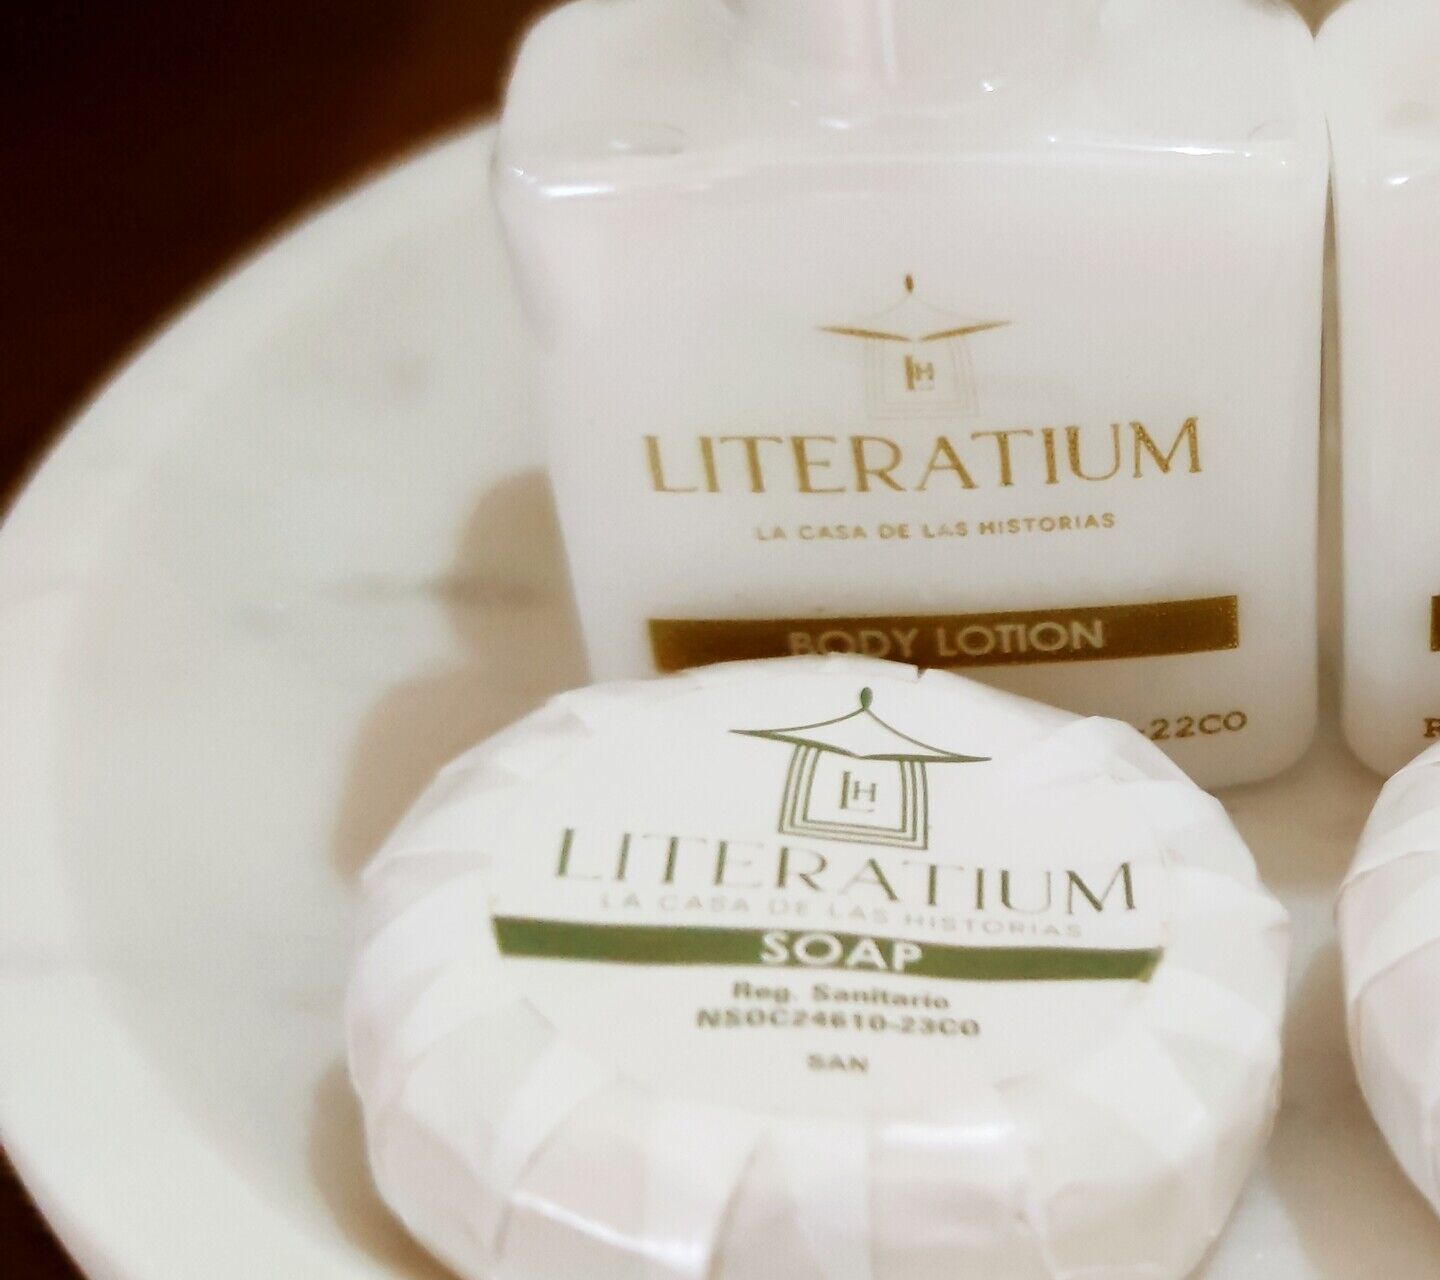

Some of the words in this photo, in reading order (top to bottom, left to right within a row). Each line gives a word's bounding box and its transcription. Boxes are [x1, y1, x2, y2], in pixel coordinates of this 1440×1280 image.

[642, 416, 1204, 495] LITERATIUM
[755, 525, 787, 541] LA
[799, 523, 867, 541] CASA
[878, 522, 910, 540] DE
[922, 521, 969, 539] LAS
[978, 511, 1116, 536] HISTORIAS
[788, 626, 920, 658] BODY
[936, 618, 1105, 657] LOTION
[553, 827, 1138, 915] LITERATIUM
[601, 892, 642, 910] LA
[657, 893, 752, 913] CASA
[768, 898, 810, 917] DE
[829, 901, 890, 924] LAS
[903, 911, 1083, 939] HISTORIAS
[760, 931, 923, 973] SOAP
[812, 983, 950, 1009] Sanitario
[807, 1052, 869, 1072] SAN
